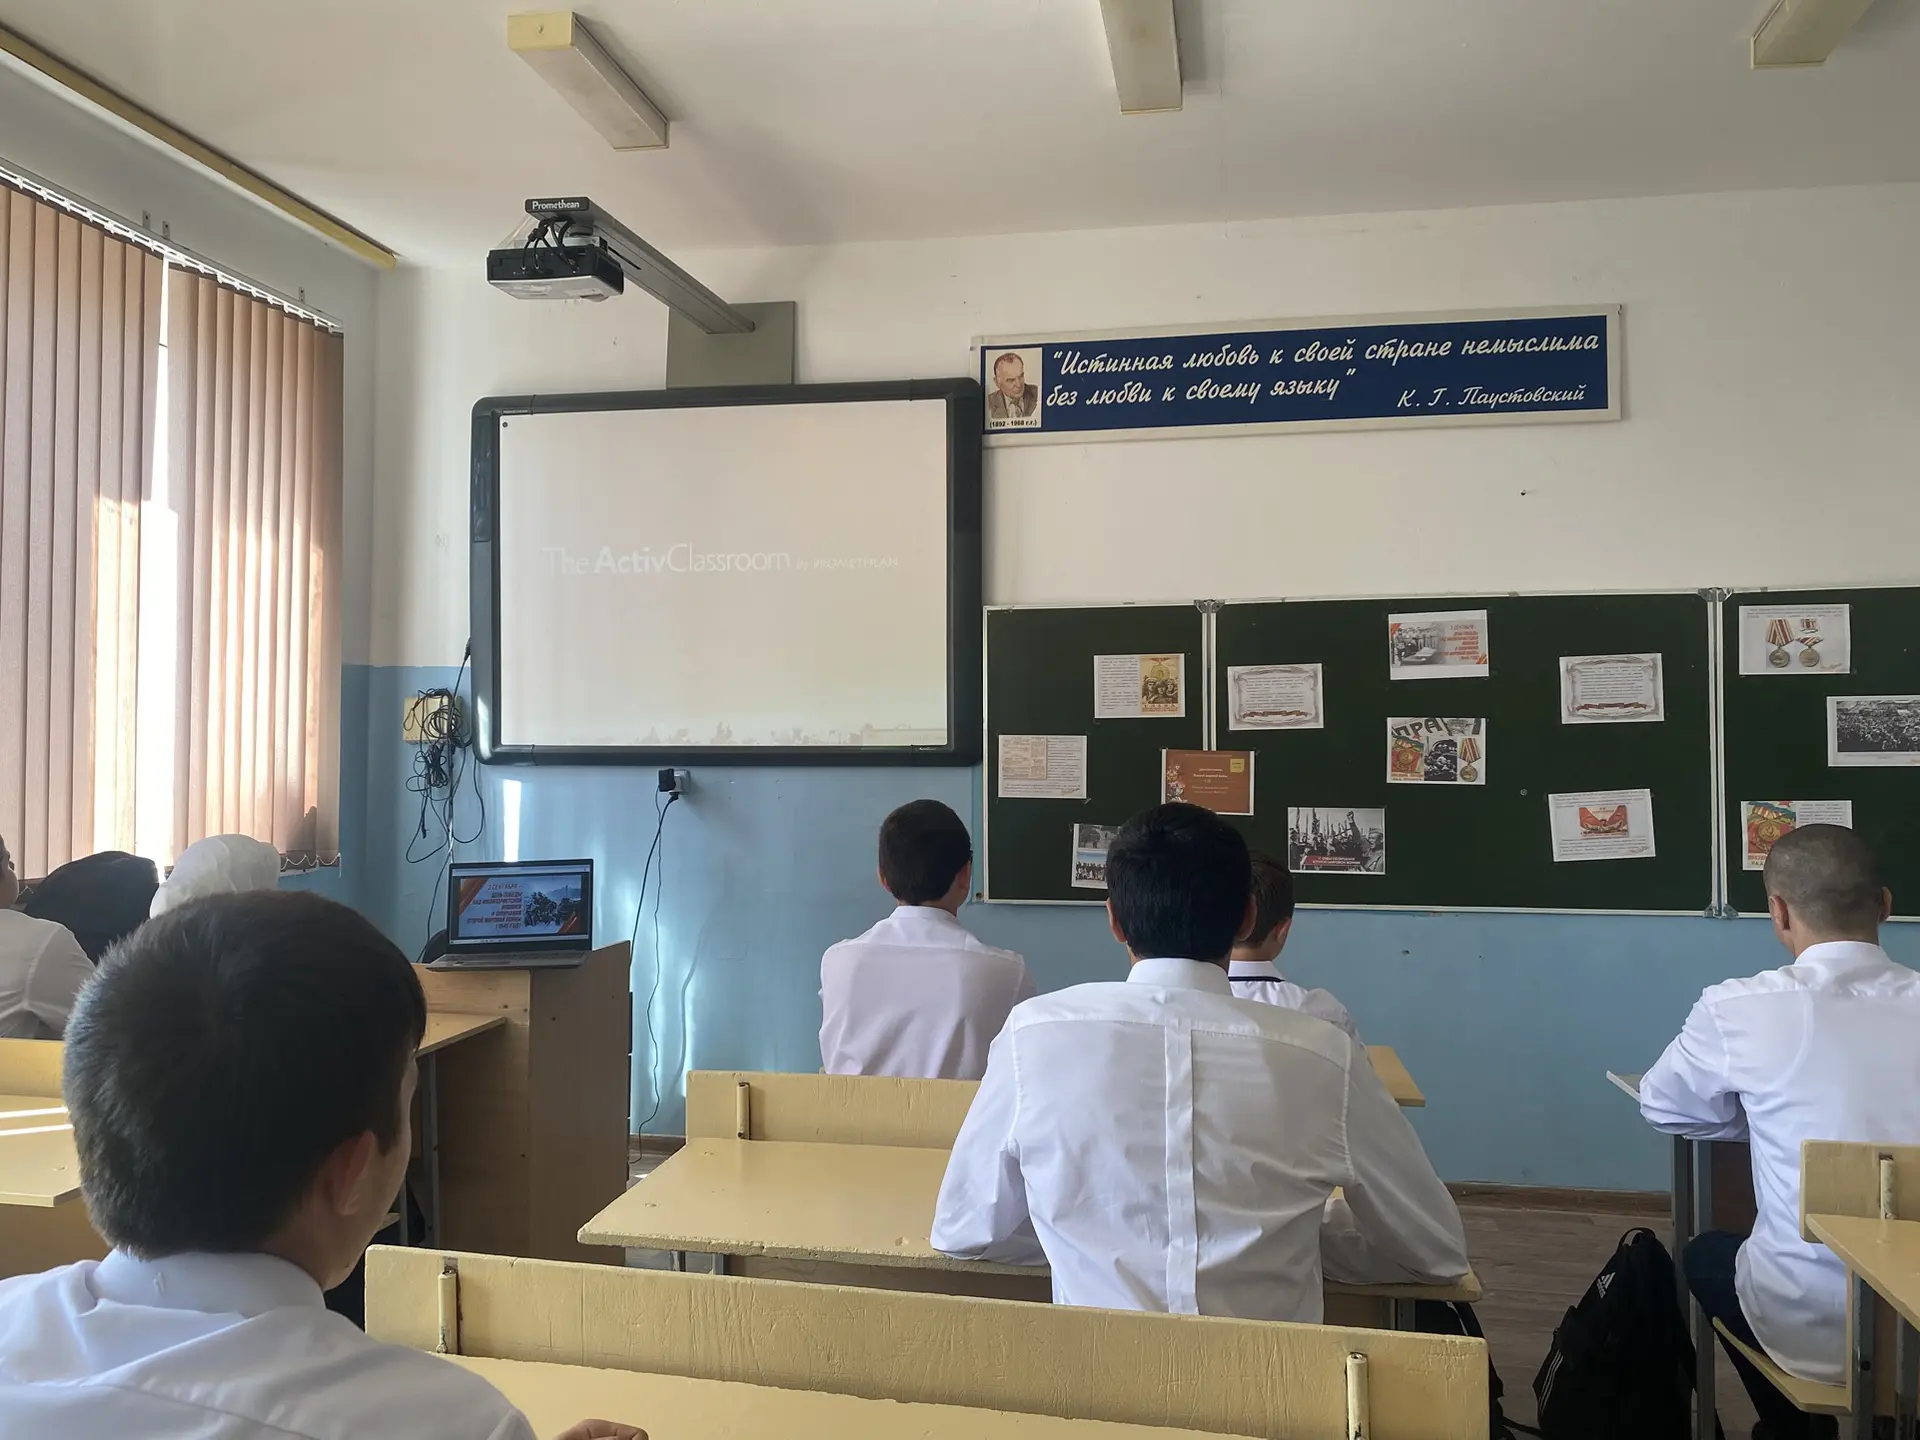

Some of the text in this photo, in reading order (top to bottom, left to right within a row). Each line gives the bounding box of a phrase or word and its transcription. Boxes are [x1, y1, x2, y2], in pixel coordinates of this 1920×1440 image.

[532, 199, 580, 210] Promethean
[1182, 343, 1260, 369] любовь
[1268, 348, 1284, 364] к
[1293, 338, 1357, 363] своей
[1365, 338, 1452, 367] стране
[1461, 333, 1600, 355] немыслима
[1046, 384, 1078, 407] без
[1085, 380, 1152, 405] любви
[1162, 386, 1176, 402] к
[1185, 380, 1262, 405] своему
[1457, 384, 1588, 410] Паустовский
[541, 547, 589, 577] The
[593, 542, 791, 575] ActivClassroom
